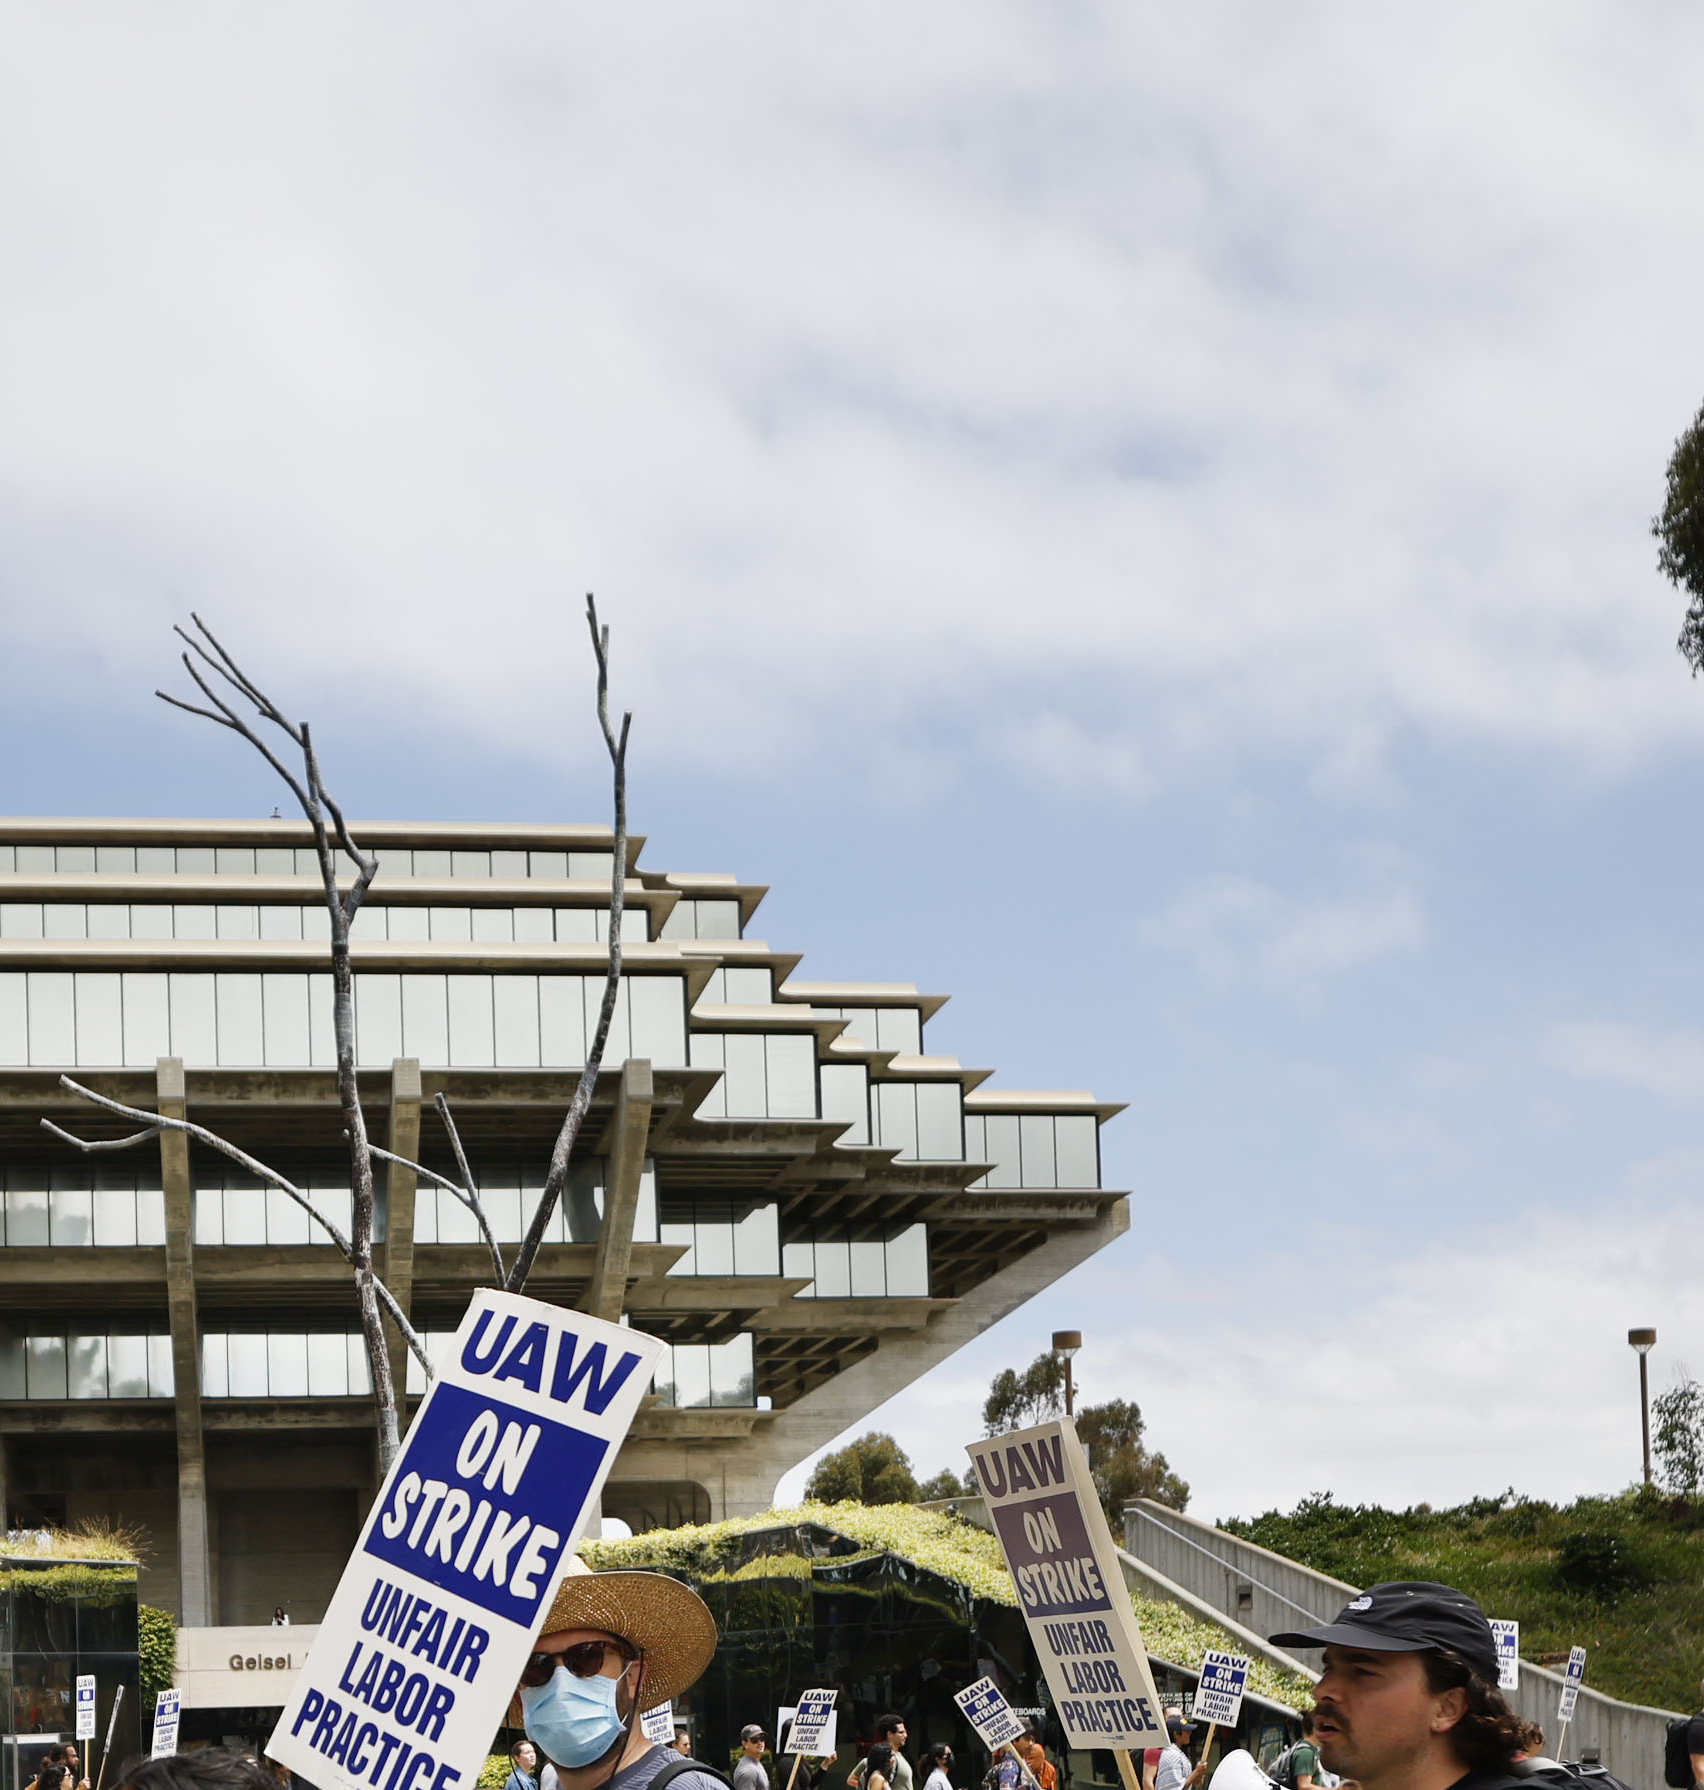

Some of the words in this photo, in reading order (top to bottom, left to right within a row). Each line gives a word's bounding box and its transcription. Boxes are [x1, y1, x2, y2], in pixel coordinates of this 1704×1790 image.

[461, 1309, 642, 1416] UAW
[456, 1409, 542, 1496] ON
[975, 1435, 1066, 1498] UAW
[381, 1471, 559, 1600] STRIKE
[1023, 1507, 1062, 1555] ON
[1017, 1556, 1105, 1608] STRIKE
[360, 1578, 490, 1684] UNFAIR
[1043, 1619, 1115, 1657] UNFAIR
[229, 1653, 291, 1671] Geisel
[1209, 1654, 1247, 1669] UAW
[1060, 1660, 1127, 1694] LABOR
[1216, 1668, 1232, 1679] ON
[78, 1679, 93, 1687] UAW
[1203, 1677, 1242, 1694] STRIKE
[159, 1691, 179, 1702] UAW
[338, 1641, 456, 1743] LABOR
[804, 1693, 835, 1702] UAW
[959, 1681, 990, 1703] UAW
[1205, 1692, 1234, 1705] UNFAIR
[164, 1704, 174, 1713] ON
[809, 1704, 822, 1714] ON
[975, 1696, 990, 1710] ON
[1204, 1702, 1230, 1713] LABOR
[156, 1714, 178, 1726] STRIKE
[797, 1714, 828, 1725] STRIKE
[971, 1699, 1005, 1725] STRIKE
[1060, 1698, 1158, 1733] PRACTICE
[1196, 1708, 1234, 1723] PRACTICE
[647, 1716, 667, 1728] UNFAIR
[649, 1724, 667, 1735] LABOR
[983, 1713, 1008, 1731] UNFAIR
[989, 1721, 1012, 1738] LABOR
[158, 1735, 172, 1743] LABOR
[989, 1724, 1021, 1748] PRACTICE
[155, 1742, 175, 1751] PRACTICE
